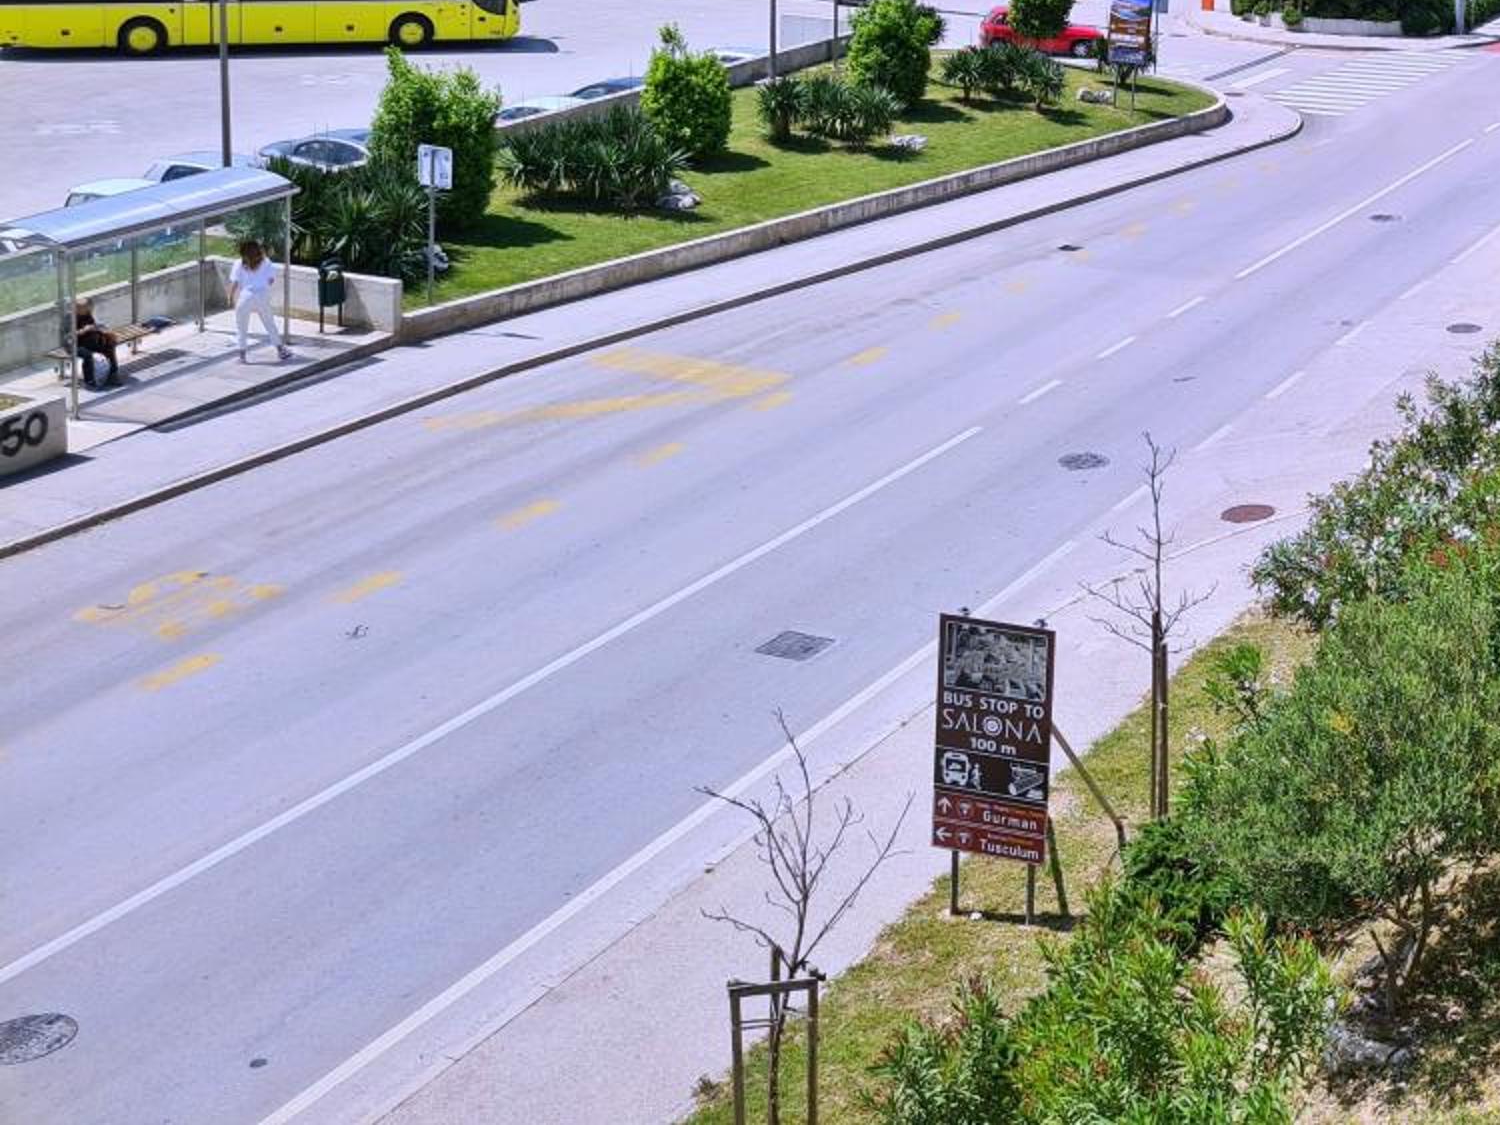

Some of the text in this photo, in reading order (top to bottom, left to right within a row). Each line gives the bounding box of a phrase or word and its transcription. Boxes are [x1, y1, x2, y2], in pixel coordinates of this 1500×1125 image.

[943, 691, 1045, 719] BUS STOP TO
[943, 708, 1042, 744] SALONA
[970, 737, 1017, 755] 100 m
[983, 810, 1037, 830] Gurman
[980, 838, 1039, 860] Tusculum
